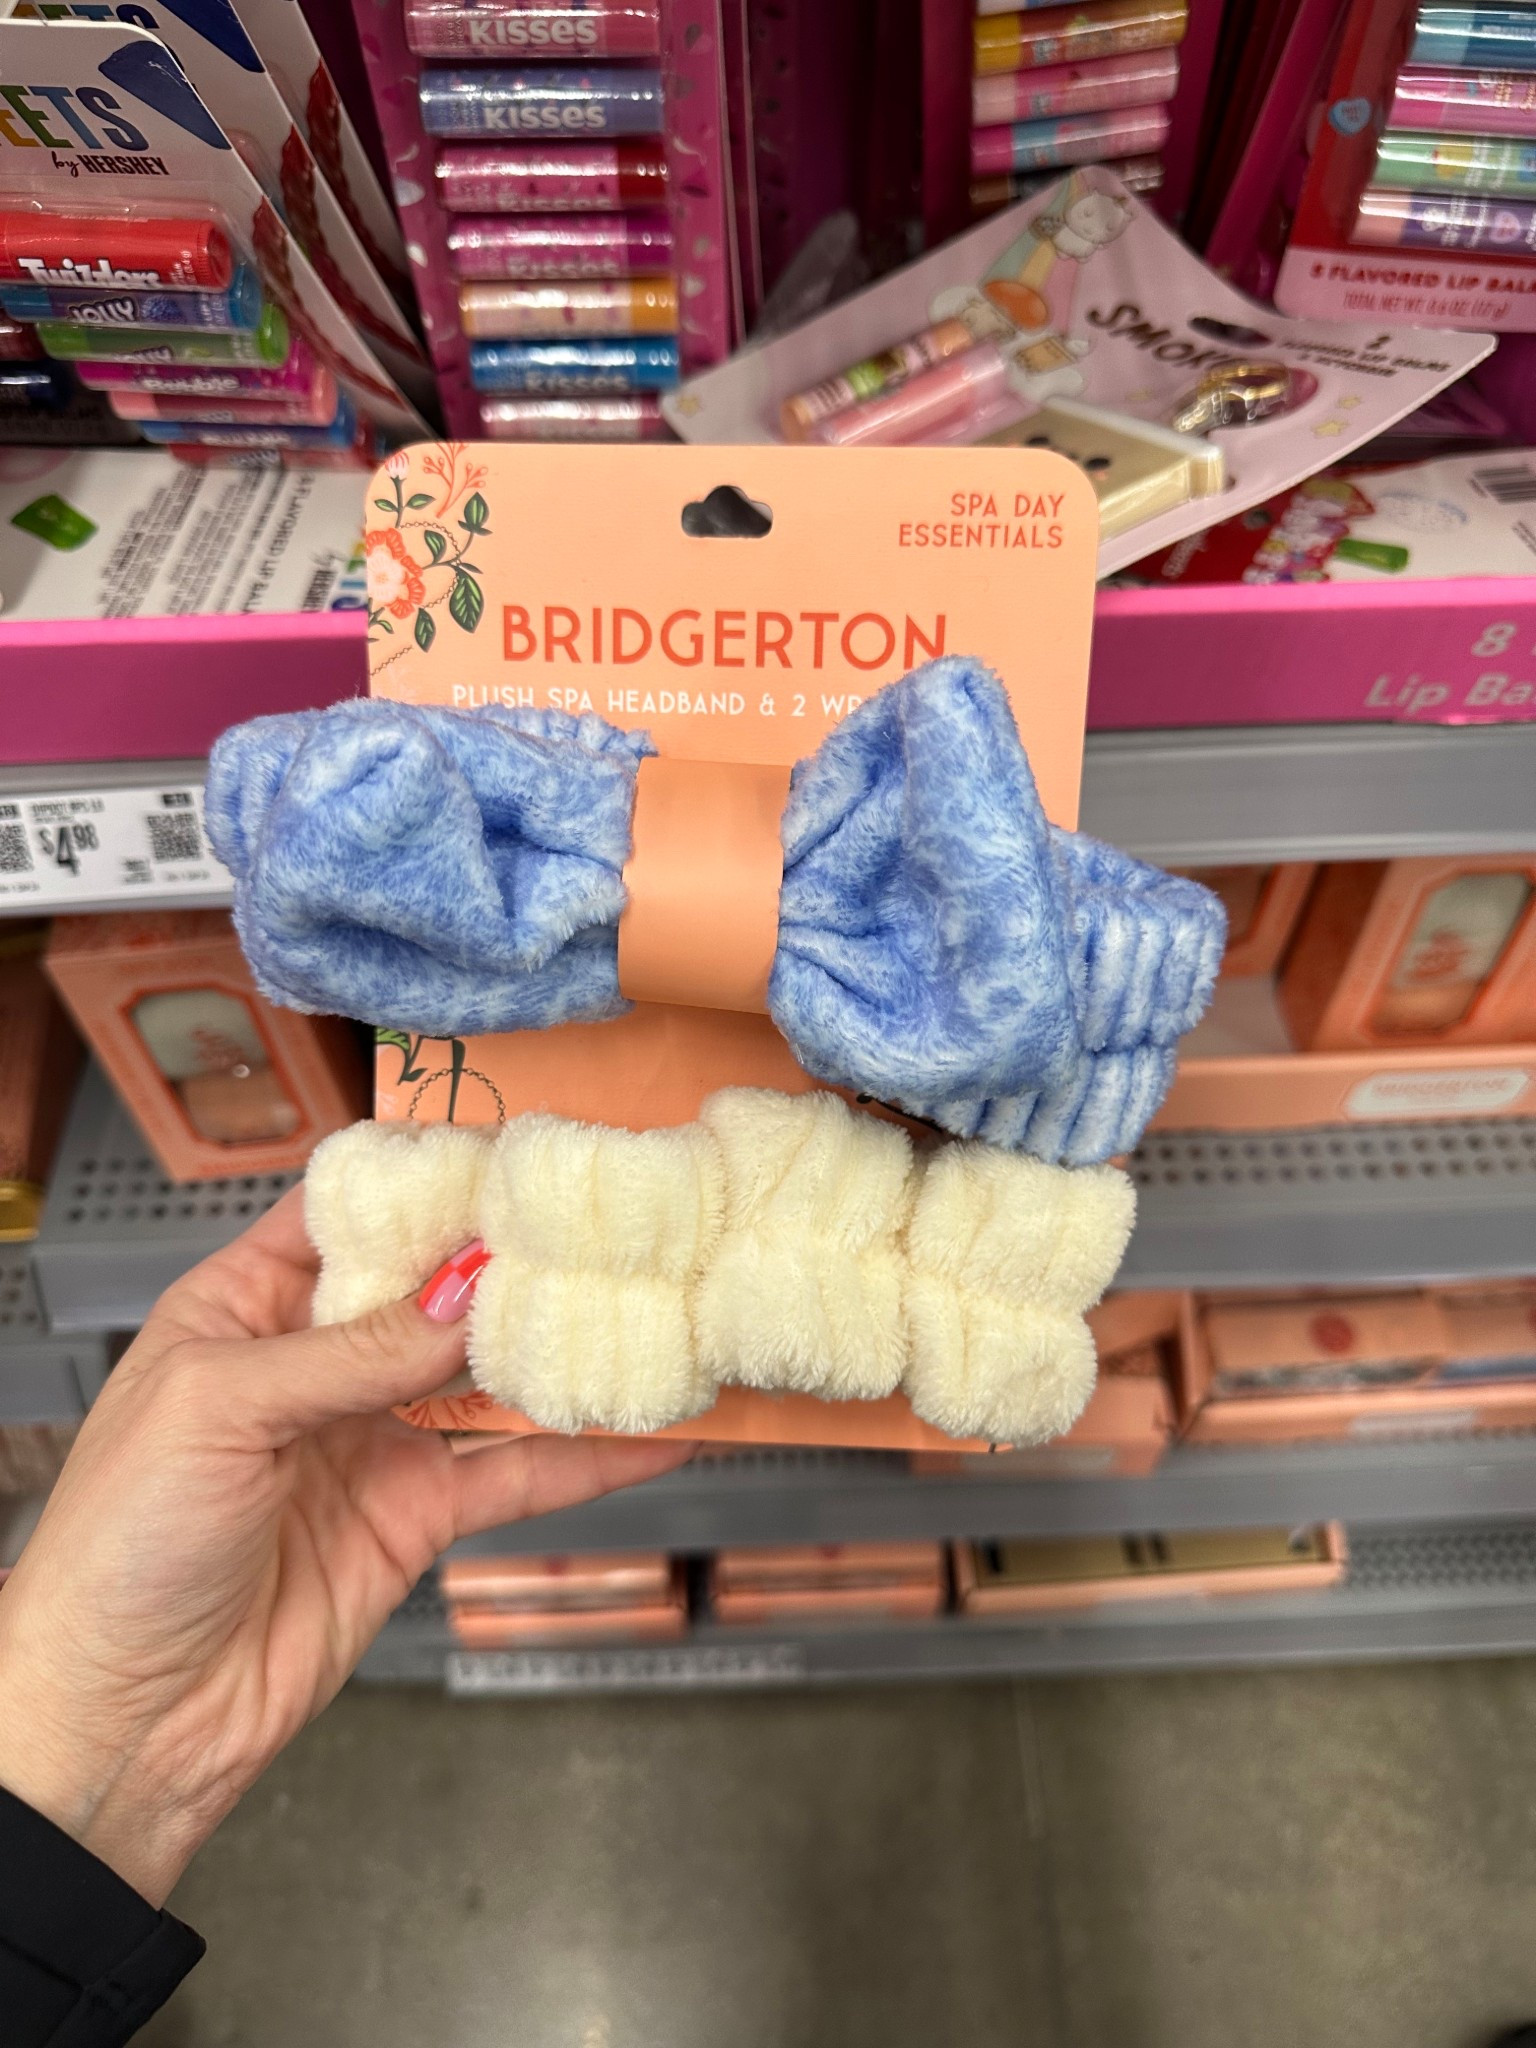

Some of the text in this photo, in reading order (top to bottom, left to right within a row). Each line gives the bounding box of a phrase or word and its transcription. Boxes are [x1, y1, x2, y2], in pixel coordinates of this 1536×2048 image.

[51, 150, 170, 178] by HERSHEY
[950, 492, 1066, 518] SPA DAY
[898, 522, 1065, 549] ESSENTIALS
[502, 604, 946, 671] BRIDGERTON
[1470, 621, 1517, 658] 8
[452, 684, 535, 709] PLUSH
[547, 687, 594, 712] SPA
[607, 688, 746, 716] HEADBAND
[758, 692, 776, 717] &
[790, 693, 807, 717] 2
[1363, 671, 1536, 715] Lip Ba
